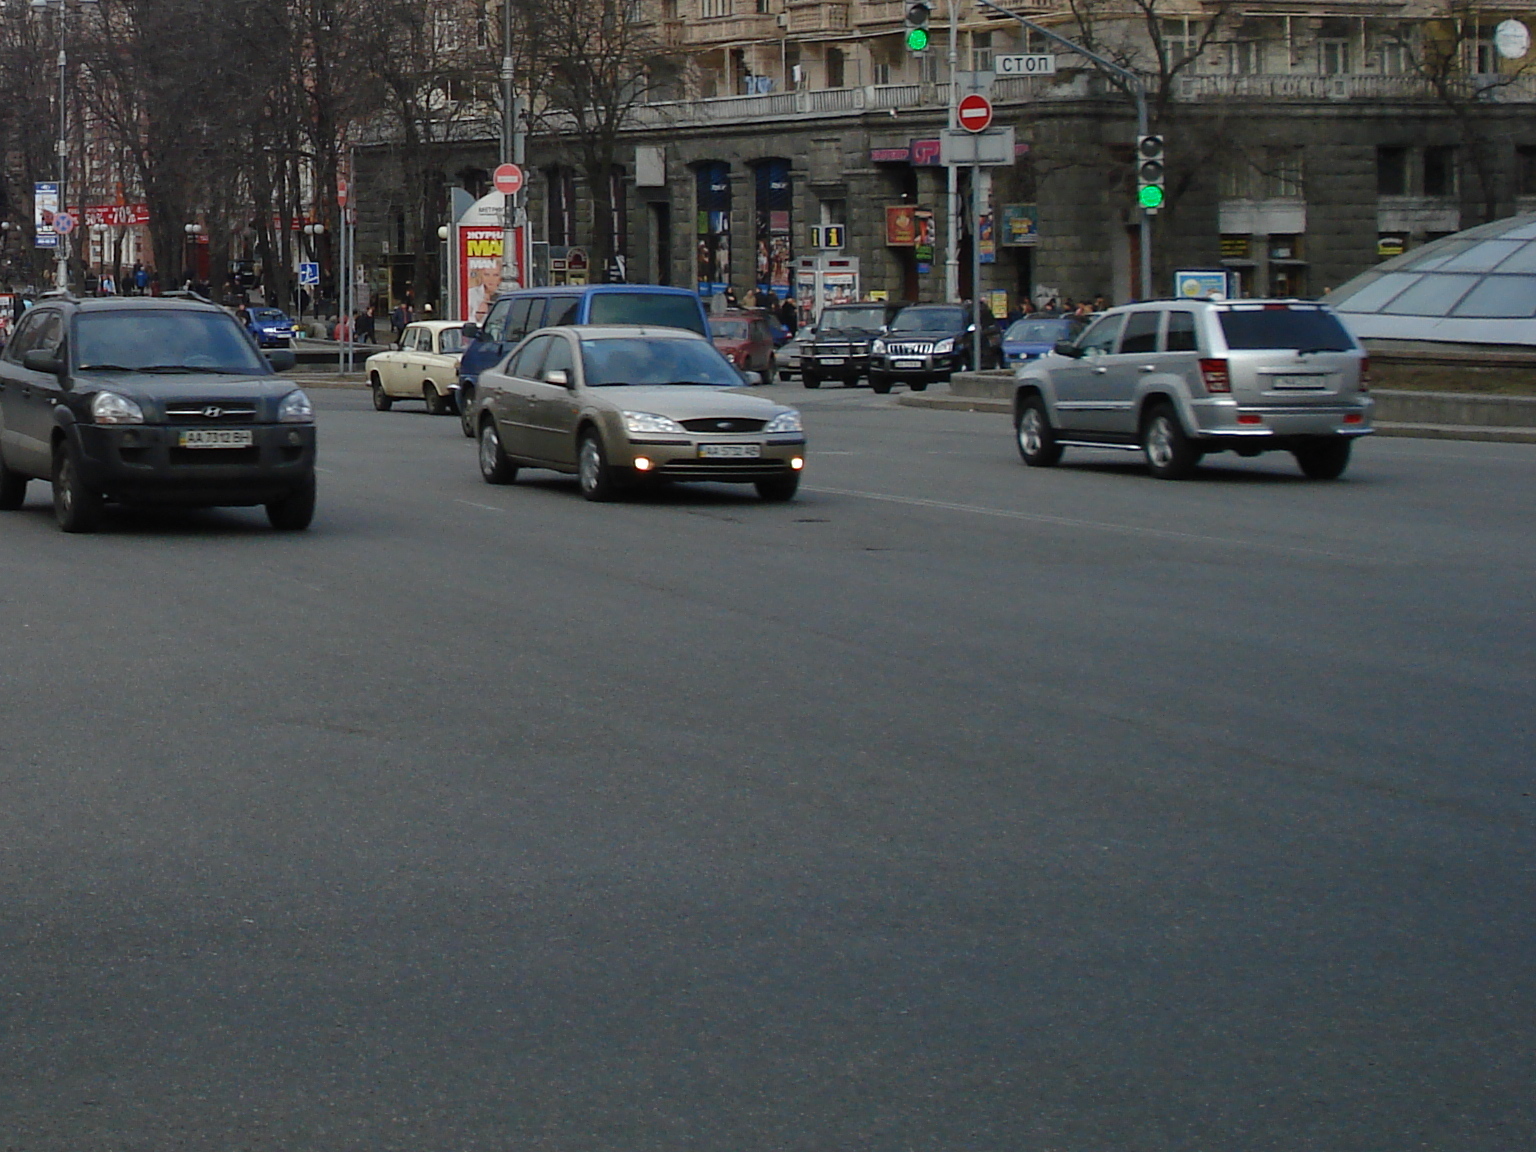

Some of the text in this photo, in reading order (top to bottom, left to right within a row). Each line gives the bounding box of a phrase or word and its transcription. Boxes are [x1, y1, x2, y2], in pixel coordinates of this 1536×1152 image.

[1002, 57, 1049, 72] СТОП
[188, 432, 250, 443] AA 7312 BH
